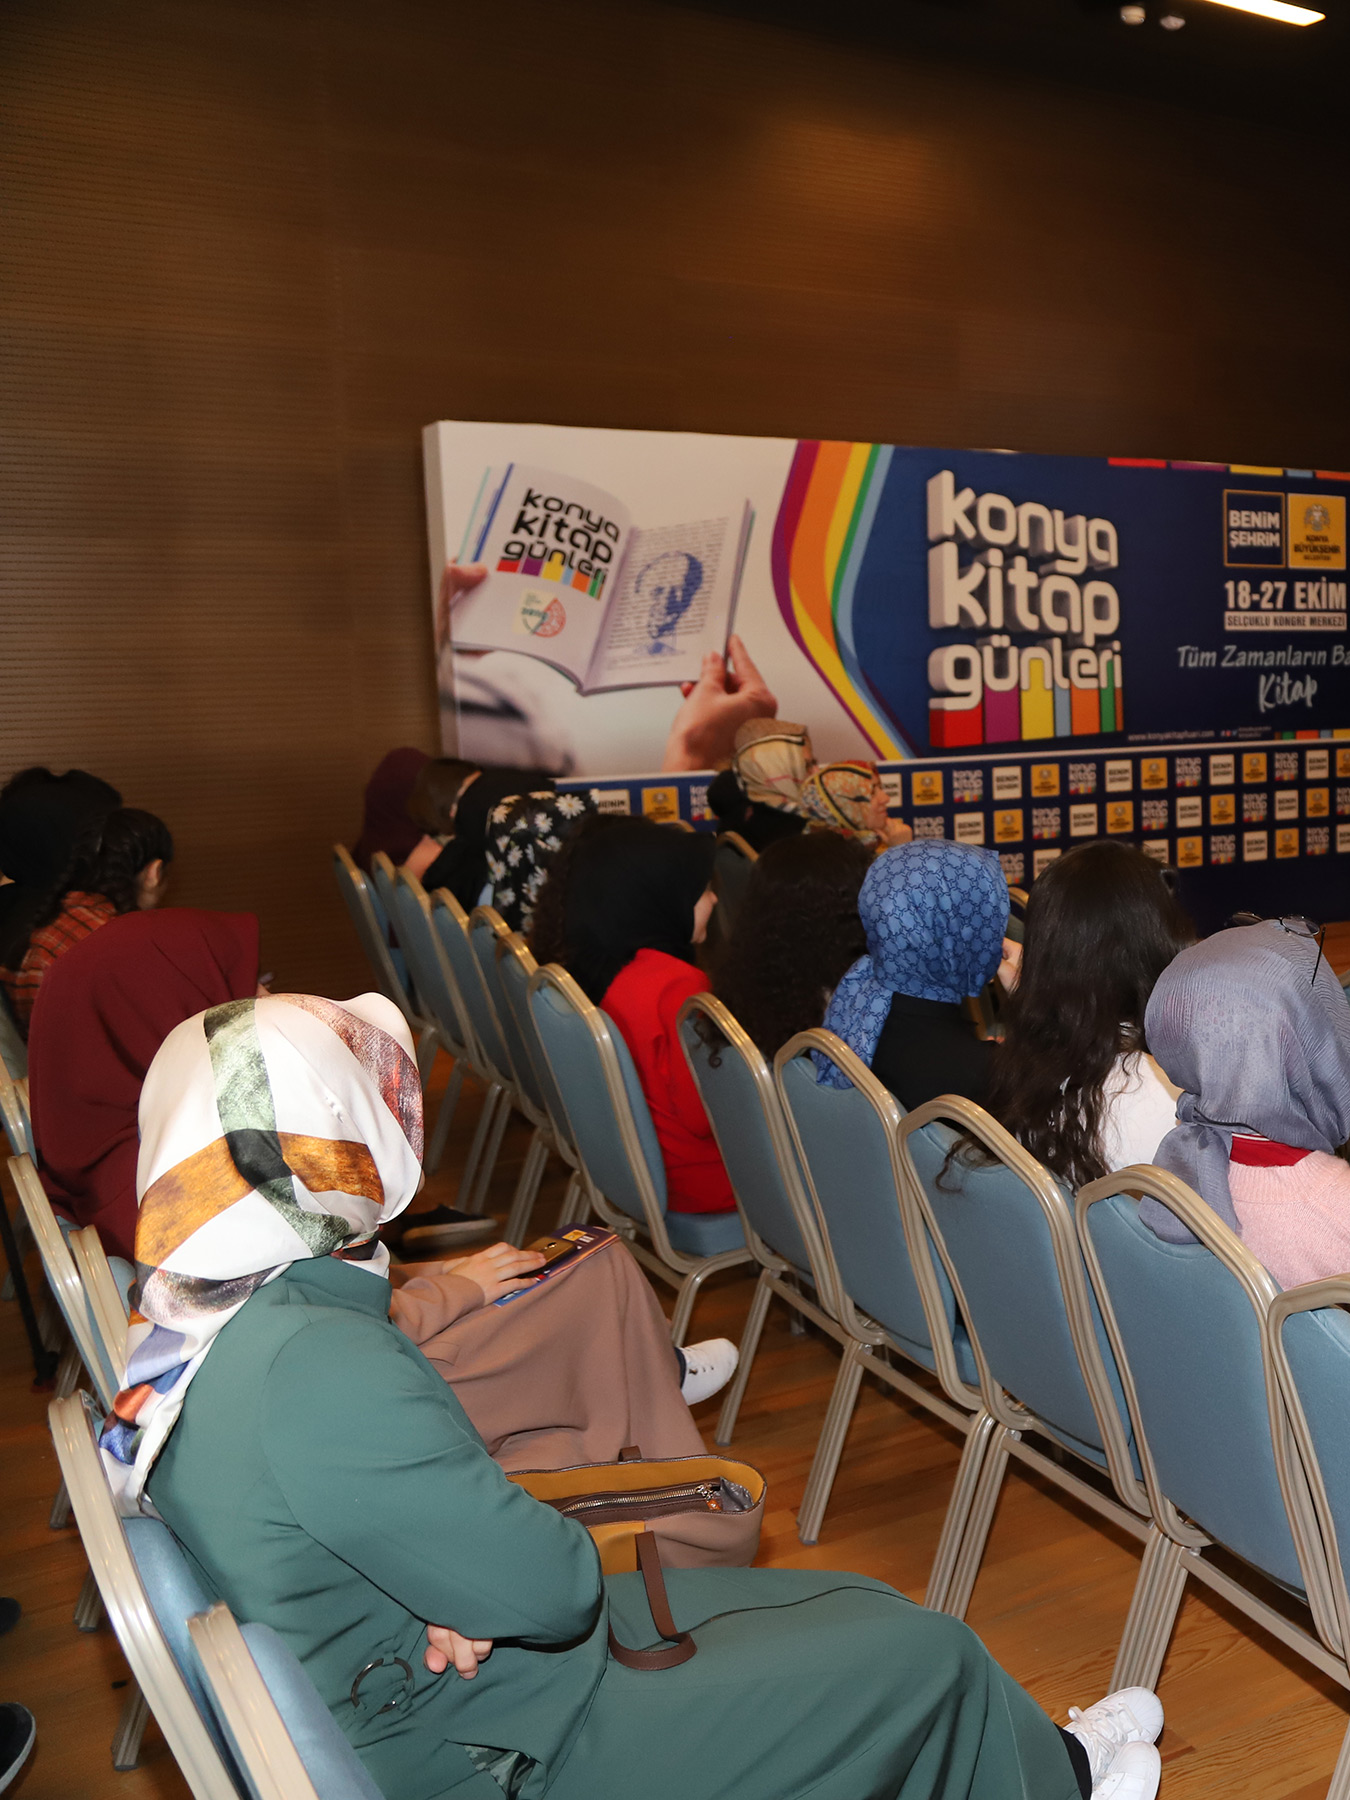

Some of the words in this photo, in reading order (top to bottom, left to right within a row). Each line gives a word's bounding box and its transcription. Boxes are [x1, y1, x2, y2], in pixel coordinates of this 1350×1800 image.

[512, 510, 613, 563] kitap
[523, 488, 620, 543] konya
[927, 469, 1119, 575] konya
[501, 540, 609, 584] günleri
[928, 541, 1120, 647] kitap
[1225, 580, 1287, 610] 18-27
[1294, 576, 1347, 610] EKİM
[1227, 615, 1271, 628] SELÇUKLU
[1273, 615, 1307, 627] KONGRE
[928, 634, 1122, 711] günleri
[1177, 645, 1217, 667] Tüm
[1221, 644, 1327, 667] Zamanların
[1258, 671, 1318, 713] Kitap
